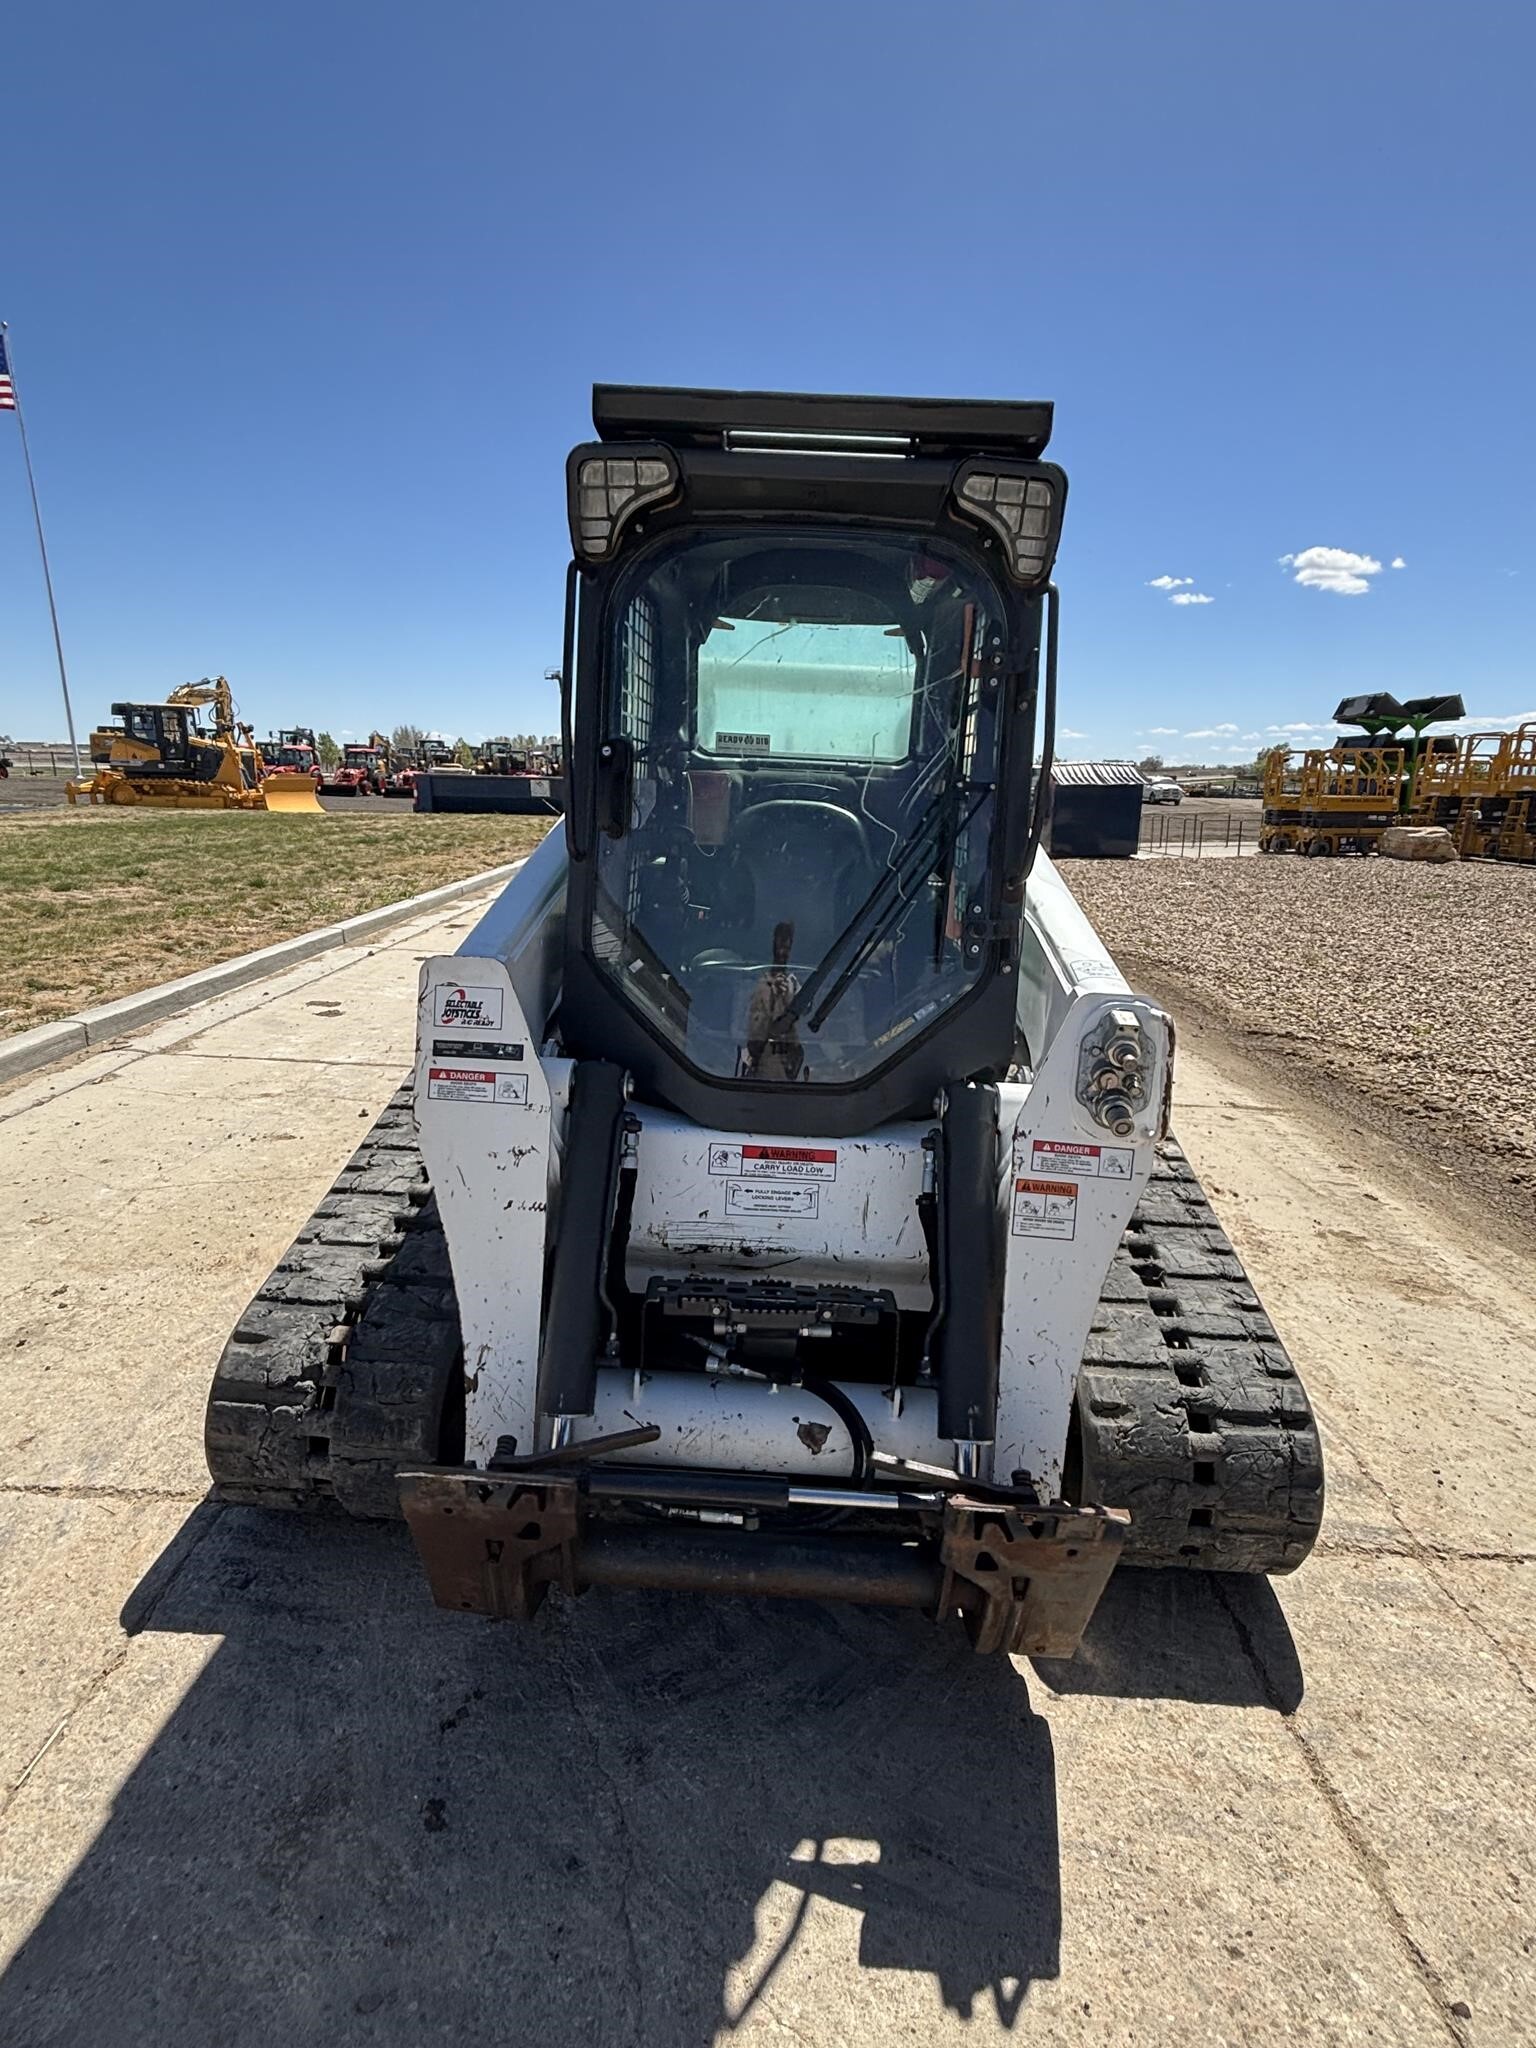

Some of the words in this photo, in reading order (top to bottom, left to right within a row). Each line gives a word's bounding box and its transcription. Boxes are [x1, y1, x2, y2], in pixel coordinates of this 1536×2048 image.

[445, 1000, 483, 1010] SELECTABLE
[441, 1009, 482, 1020] JOYSTICKS
[450, 1072, 486, 1081] DANGER
[770, 1148, 816, 1160] WARNING
[1054, 1144, 1091, 1155] DANGER
[753, 1163, 780, 1171] CARRY
[1032, 1183, 1073, 1195] WARNING
